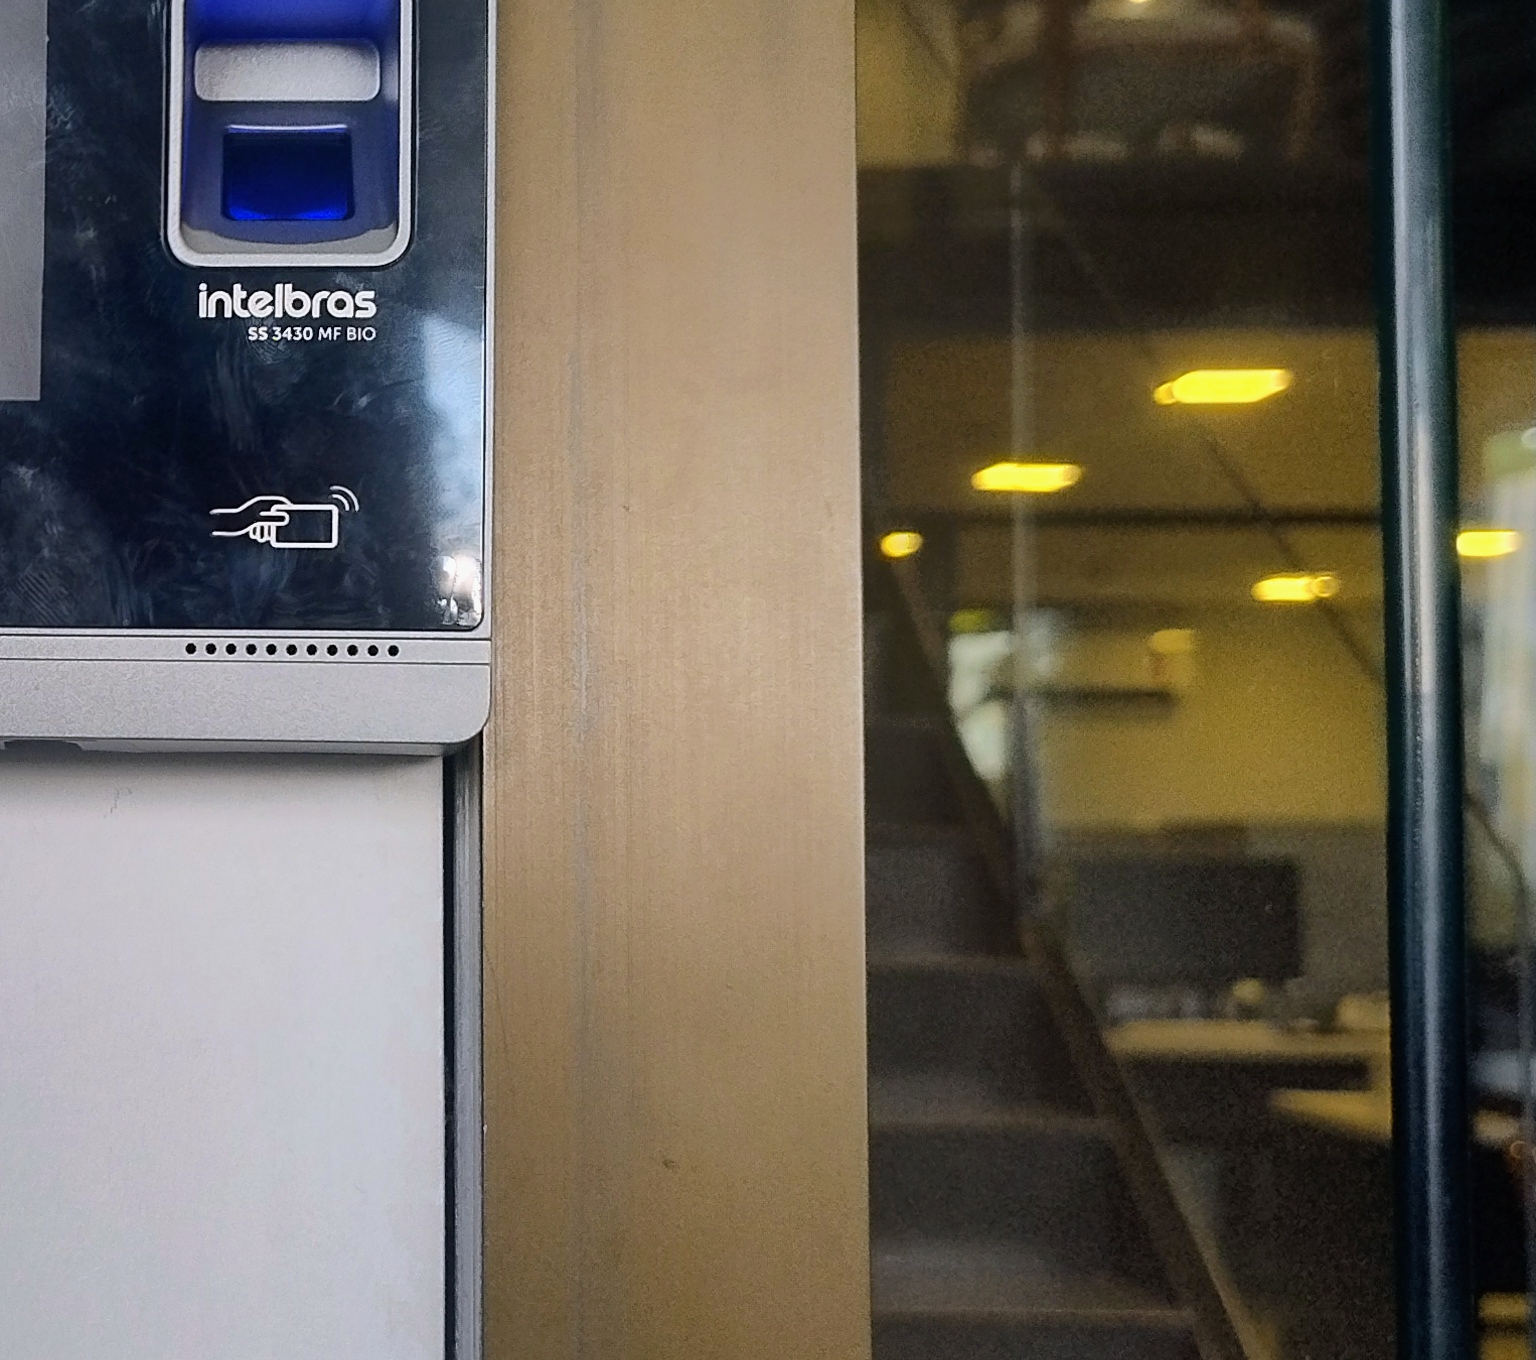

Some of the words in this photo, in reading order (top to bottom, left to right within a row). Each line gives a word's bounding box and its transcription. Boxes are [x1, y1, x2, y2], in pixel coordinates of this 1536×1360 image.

[198, 282, 377, 319] intelbras
[248, 326, 268, 341] SS
[272, 326, 314, 341] 3430
[318, 326, 342, 341] MF
[346, 326, 377, 341] BIO
